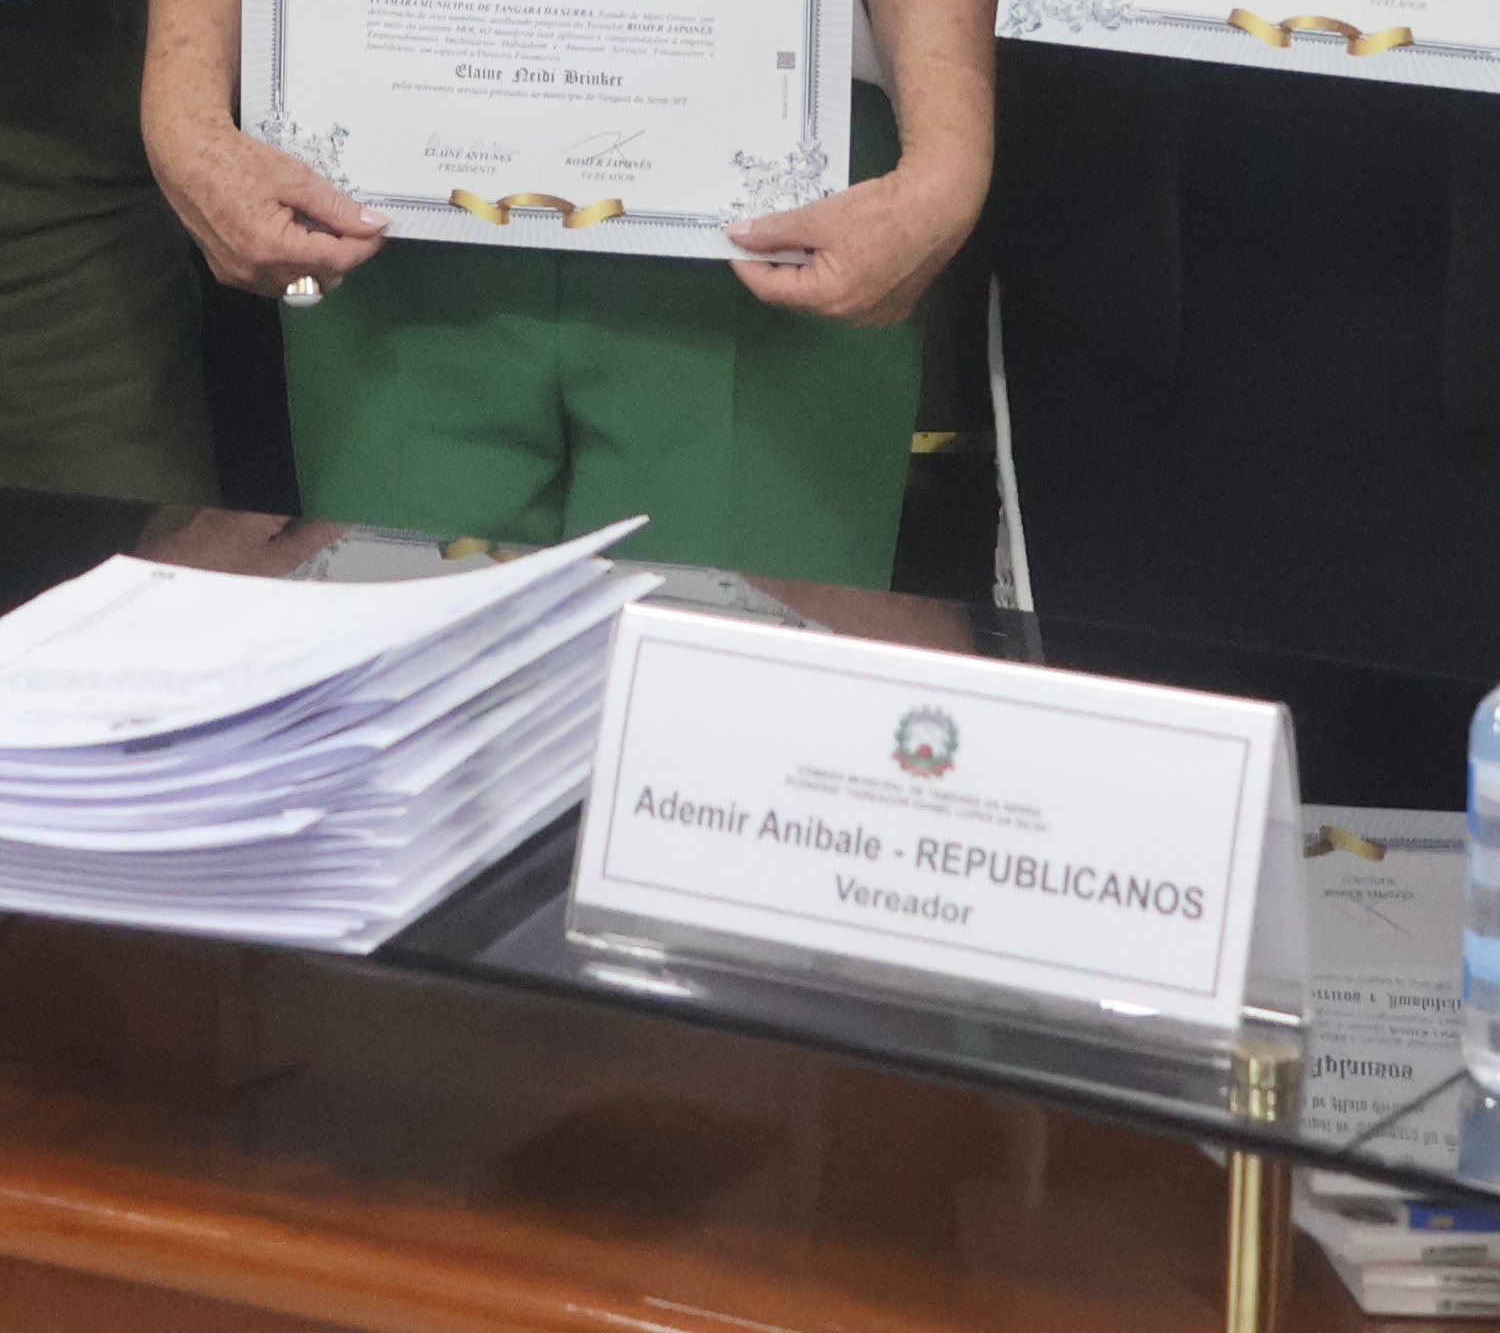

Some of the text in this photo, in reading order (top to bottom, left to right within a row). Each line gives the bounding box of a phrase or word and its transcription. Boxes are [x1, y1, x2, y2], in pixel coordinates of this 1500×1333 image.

[454, 63, 623, 86] Elaine Neidi Brinker
[634, 784, 751, 837] Ademir
[757, 808, 882, 862] Anibale
[915, 835, 1205, 922] REPUBLICANOS
[834, 873, 975, 927] Vereador
